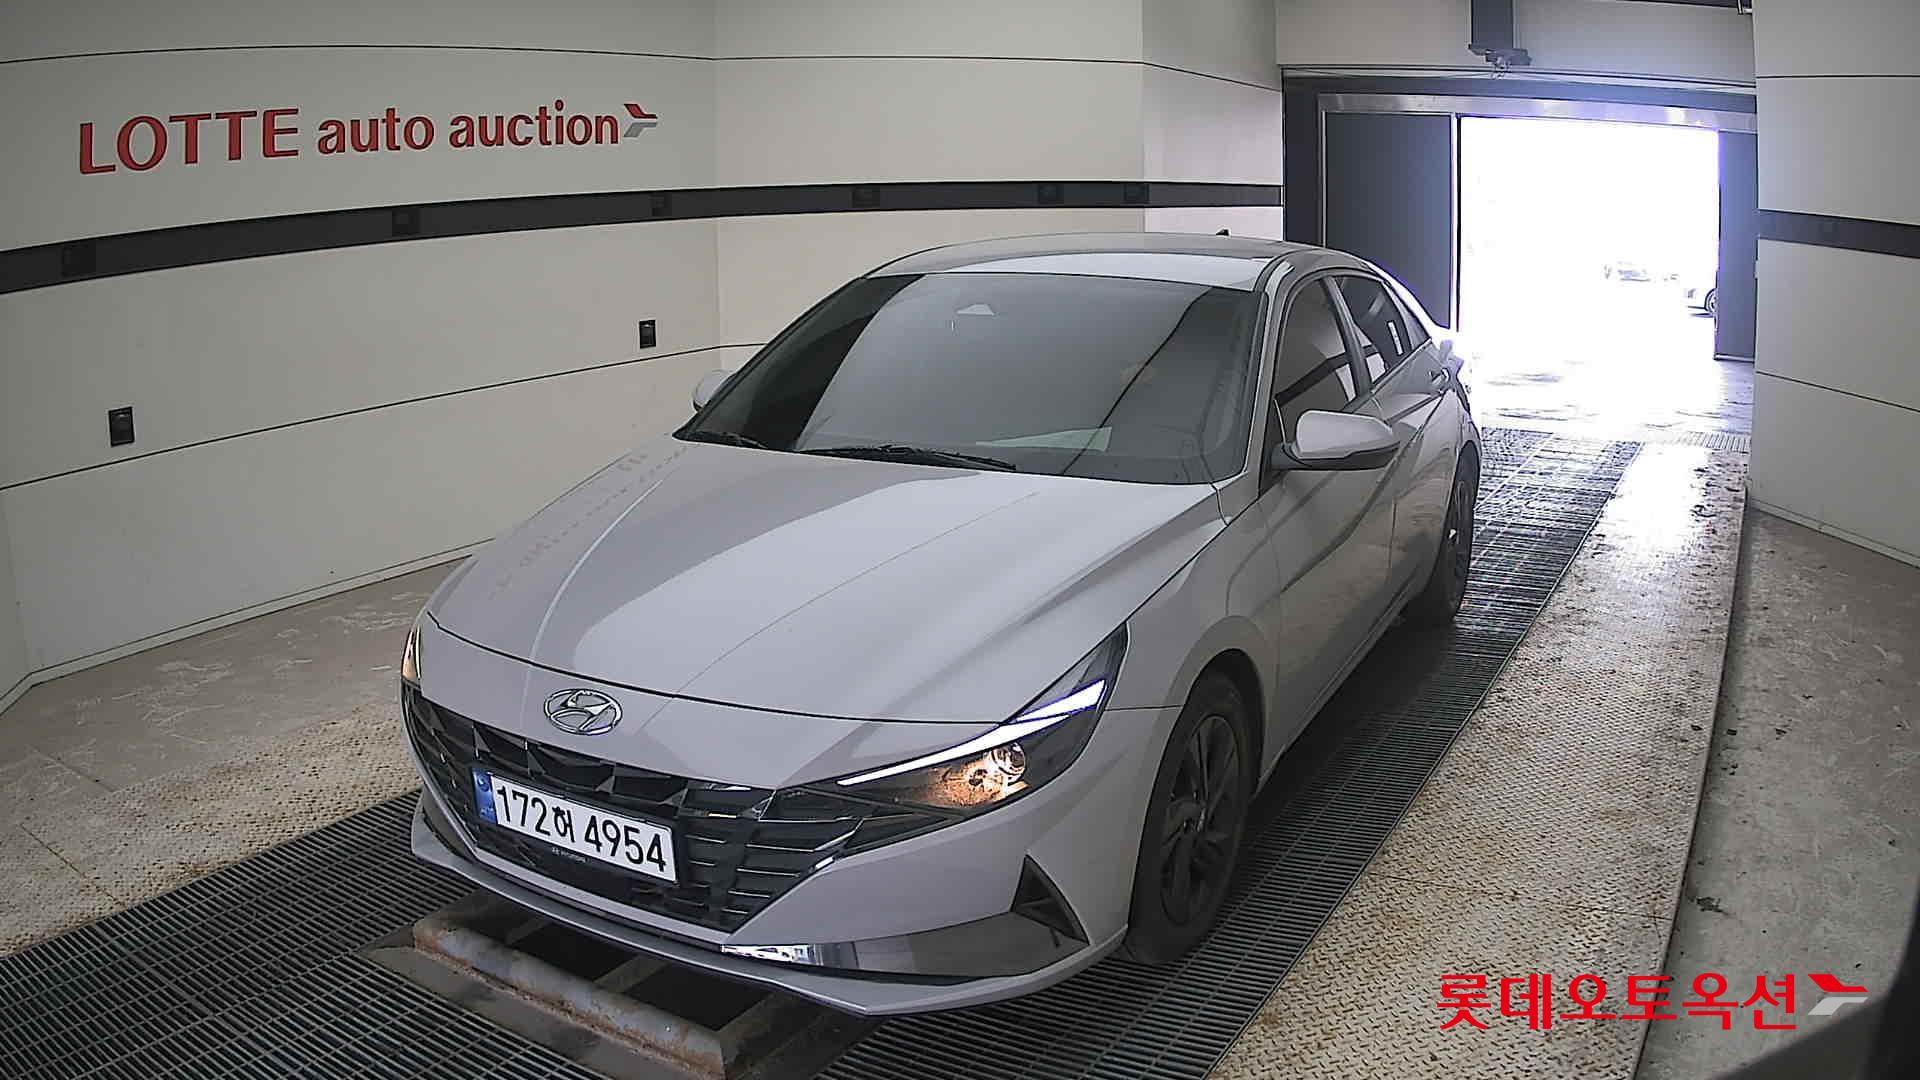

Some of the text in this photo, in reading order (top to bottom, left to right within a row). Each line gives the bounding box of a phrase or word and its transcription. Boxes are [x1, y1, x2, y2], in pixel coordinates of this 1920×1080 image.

[79, 99, 620, 175] LOTTE auto auction
[497, 785, 667, 873] 172허 4954
